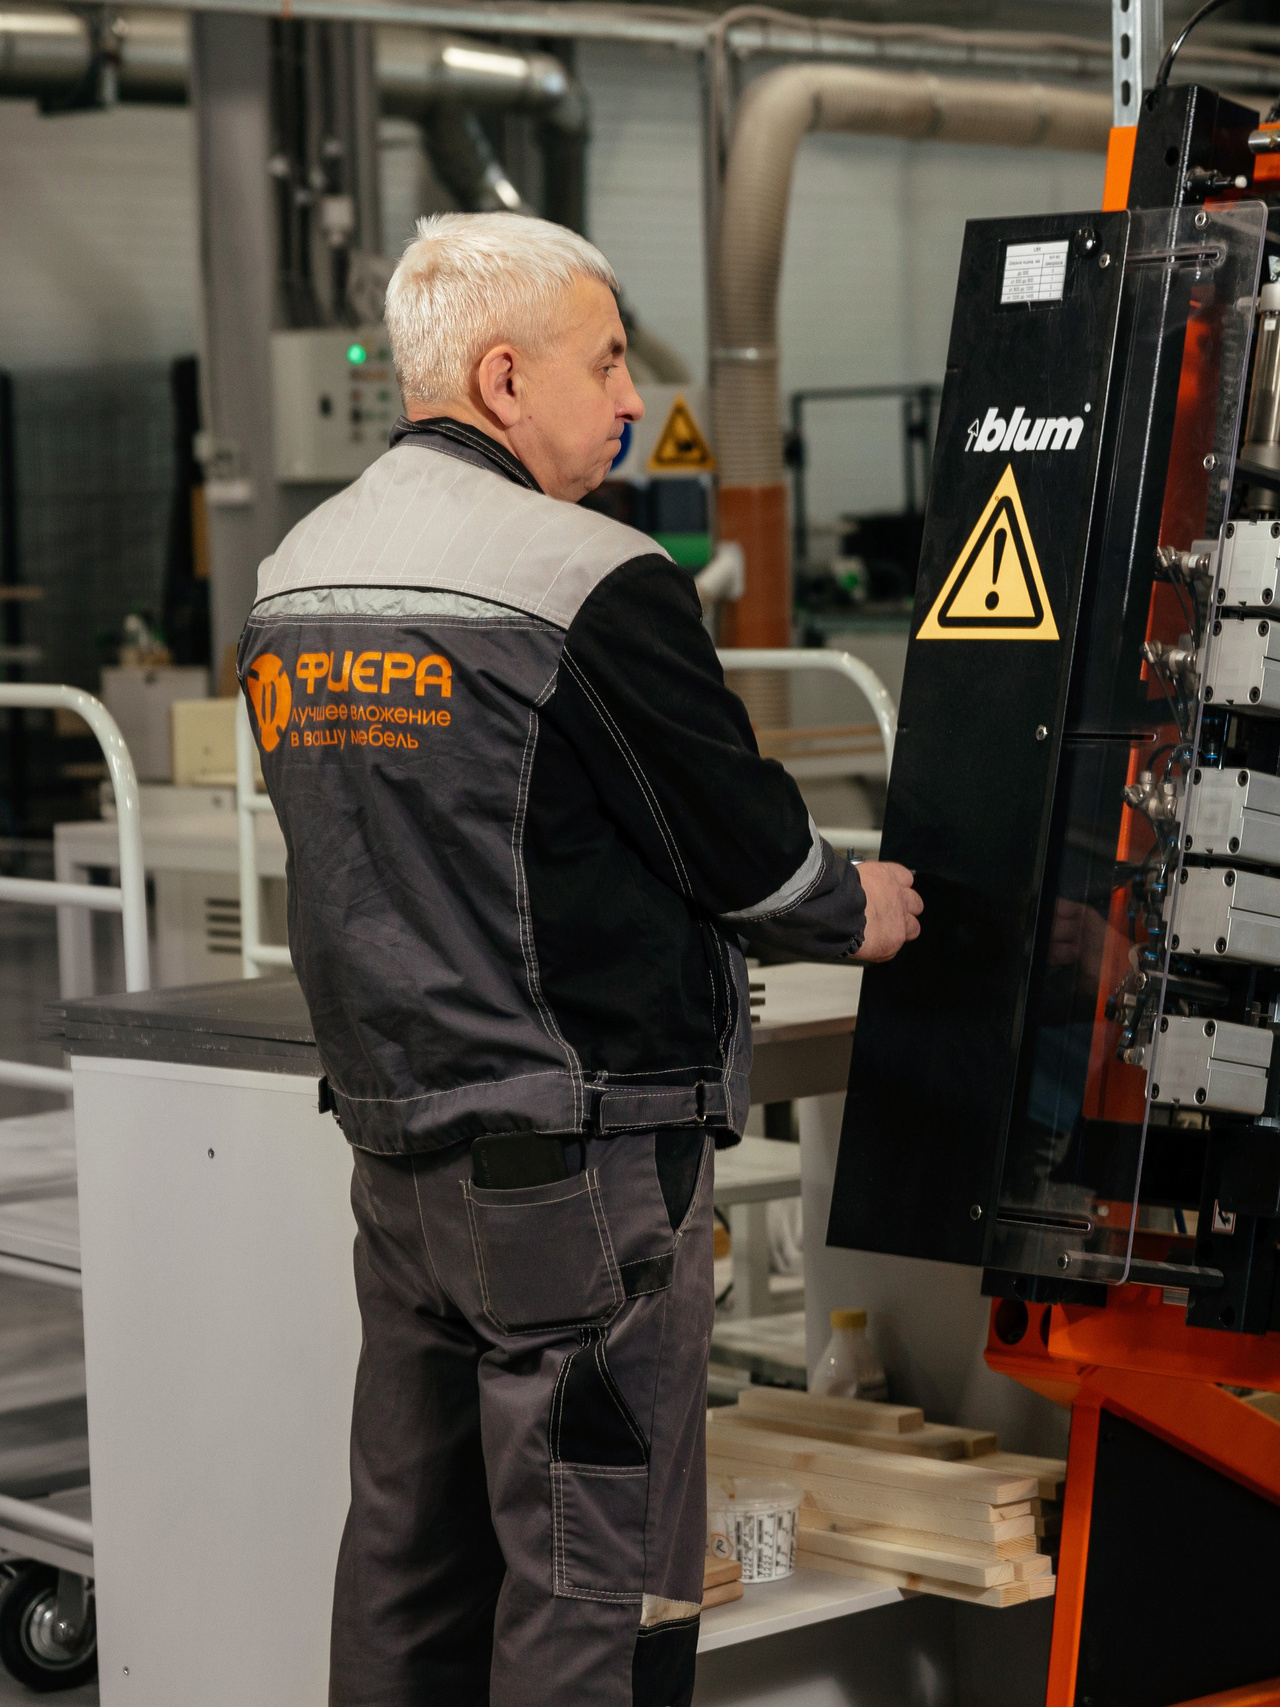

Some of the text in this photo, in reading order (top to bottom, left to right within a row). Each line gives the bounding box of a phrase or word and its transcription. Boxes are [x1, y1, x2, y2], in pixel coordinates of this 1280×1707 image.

[972, 405, 1085, 453] blum
[296, 650, 452, 698] ФИЕРА
[290, 703, 451, 727] лучшее вложение
[290, 724, 419, 750] в вашу мебель
